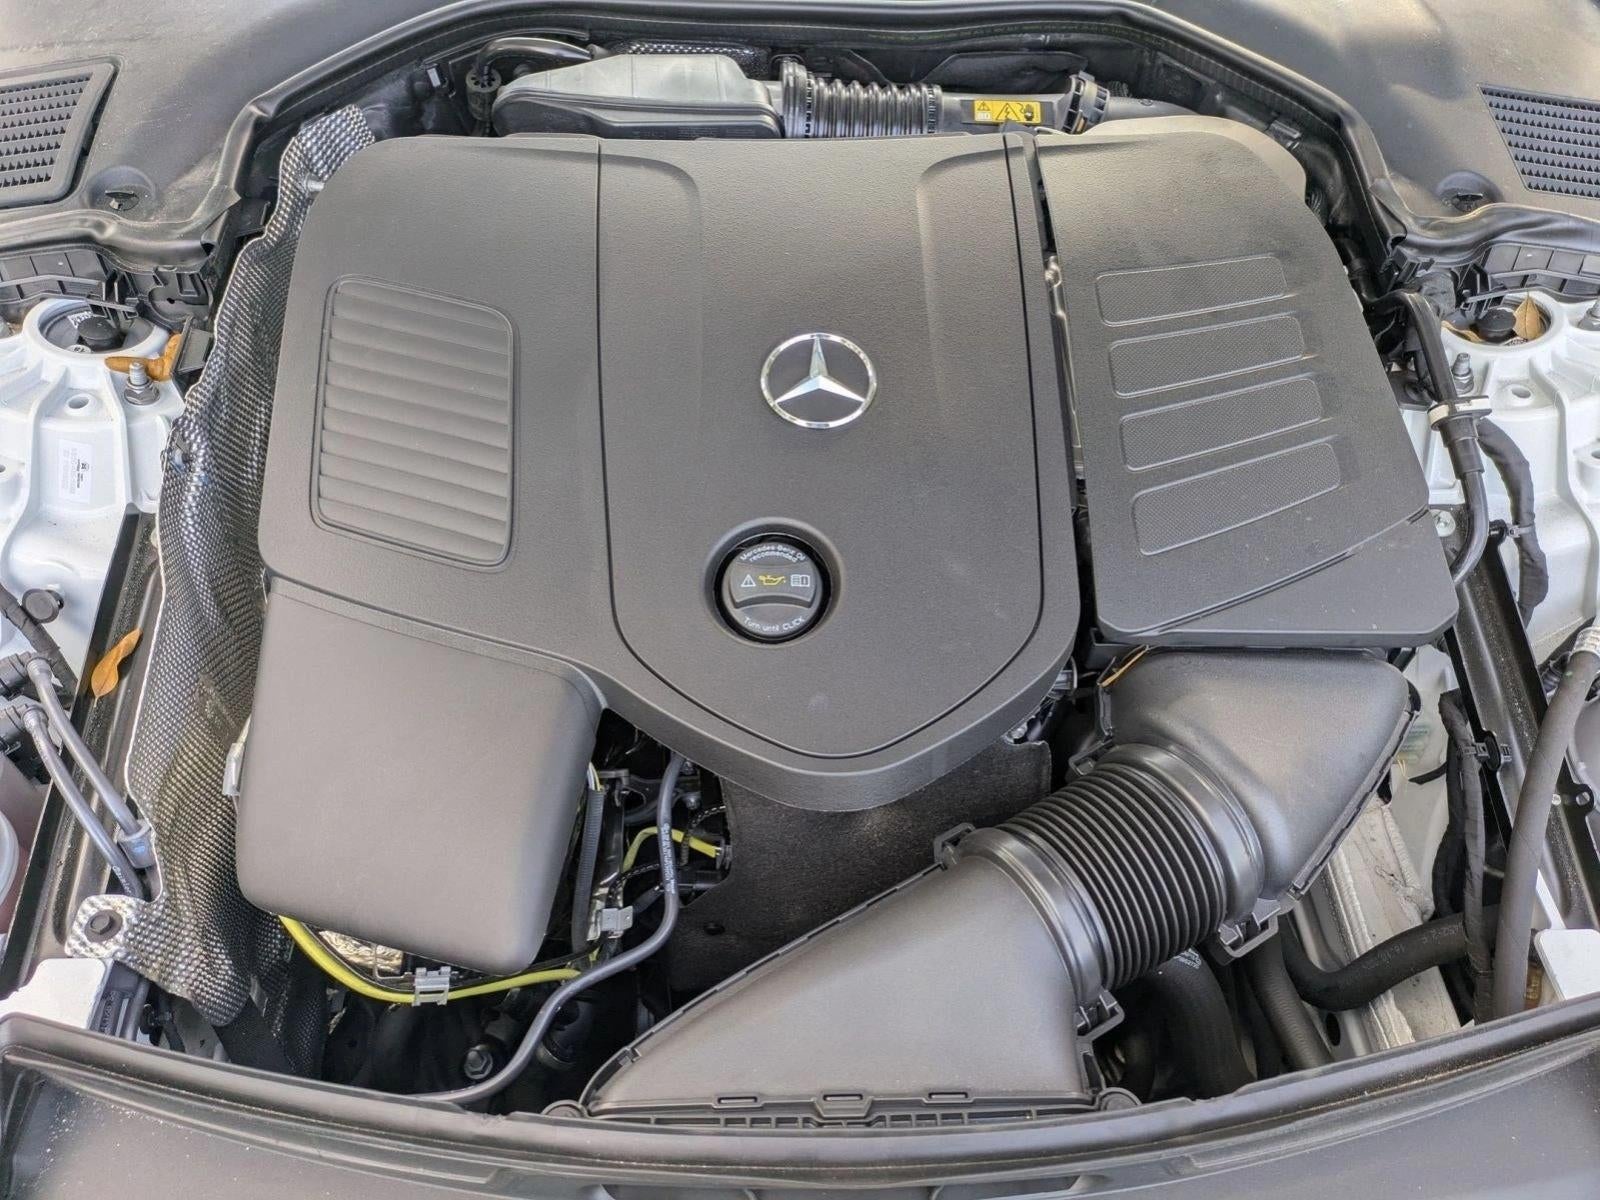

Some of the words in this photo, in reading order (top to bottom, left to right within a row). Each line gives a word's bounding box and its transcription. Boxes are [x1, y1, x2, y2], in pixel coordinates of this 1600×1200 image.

[749, 551, 798, 562] recommended
[744, 616, 760, 629] Turn
[762, 623, 780, 631] until
[782, 616, 805, 630] CLICK
